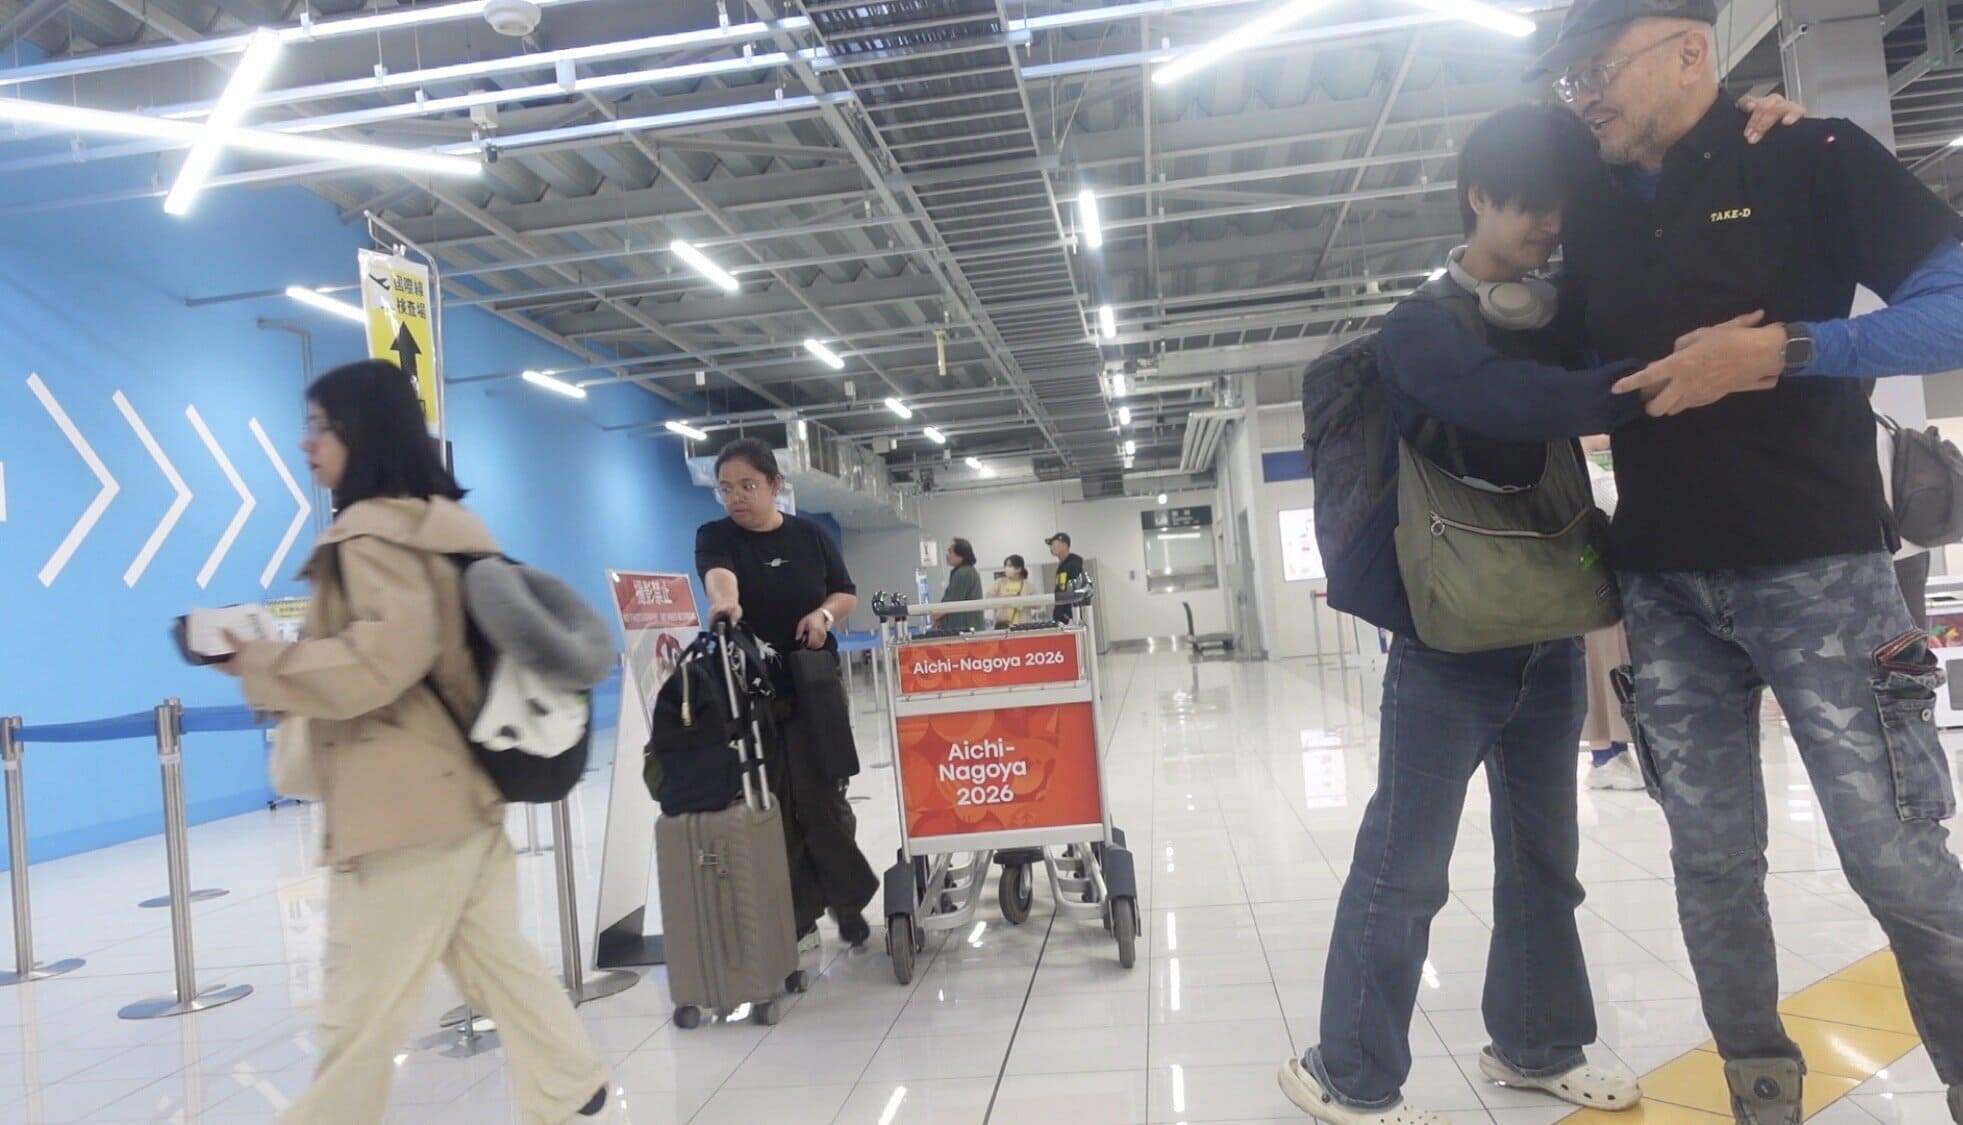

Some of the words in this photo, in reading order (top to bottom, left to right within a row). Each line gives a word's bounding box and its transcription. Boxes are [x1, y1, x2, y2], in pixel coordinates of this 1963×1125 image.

[1710, 208, 1751, 222] TAKE-D
[380, 297, 427, 319] 検査場
[913, 654, 1021, 675] Aichi-Nagoya
[1025, 651, 1064, 666] 2026
[948, 738, 1015, 761] Aichi-
[939, 760, 1026, 783] Nagoya
[957, 785, 1014, 805] 2026
